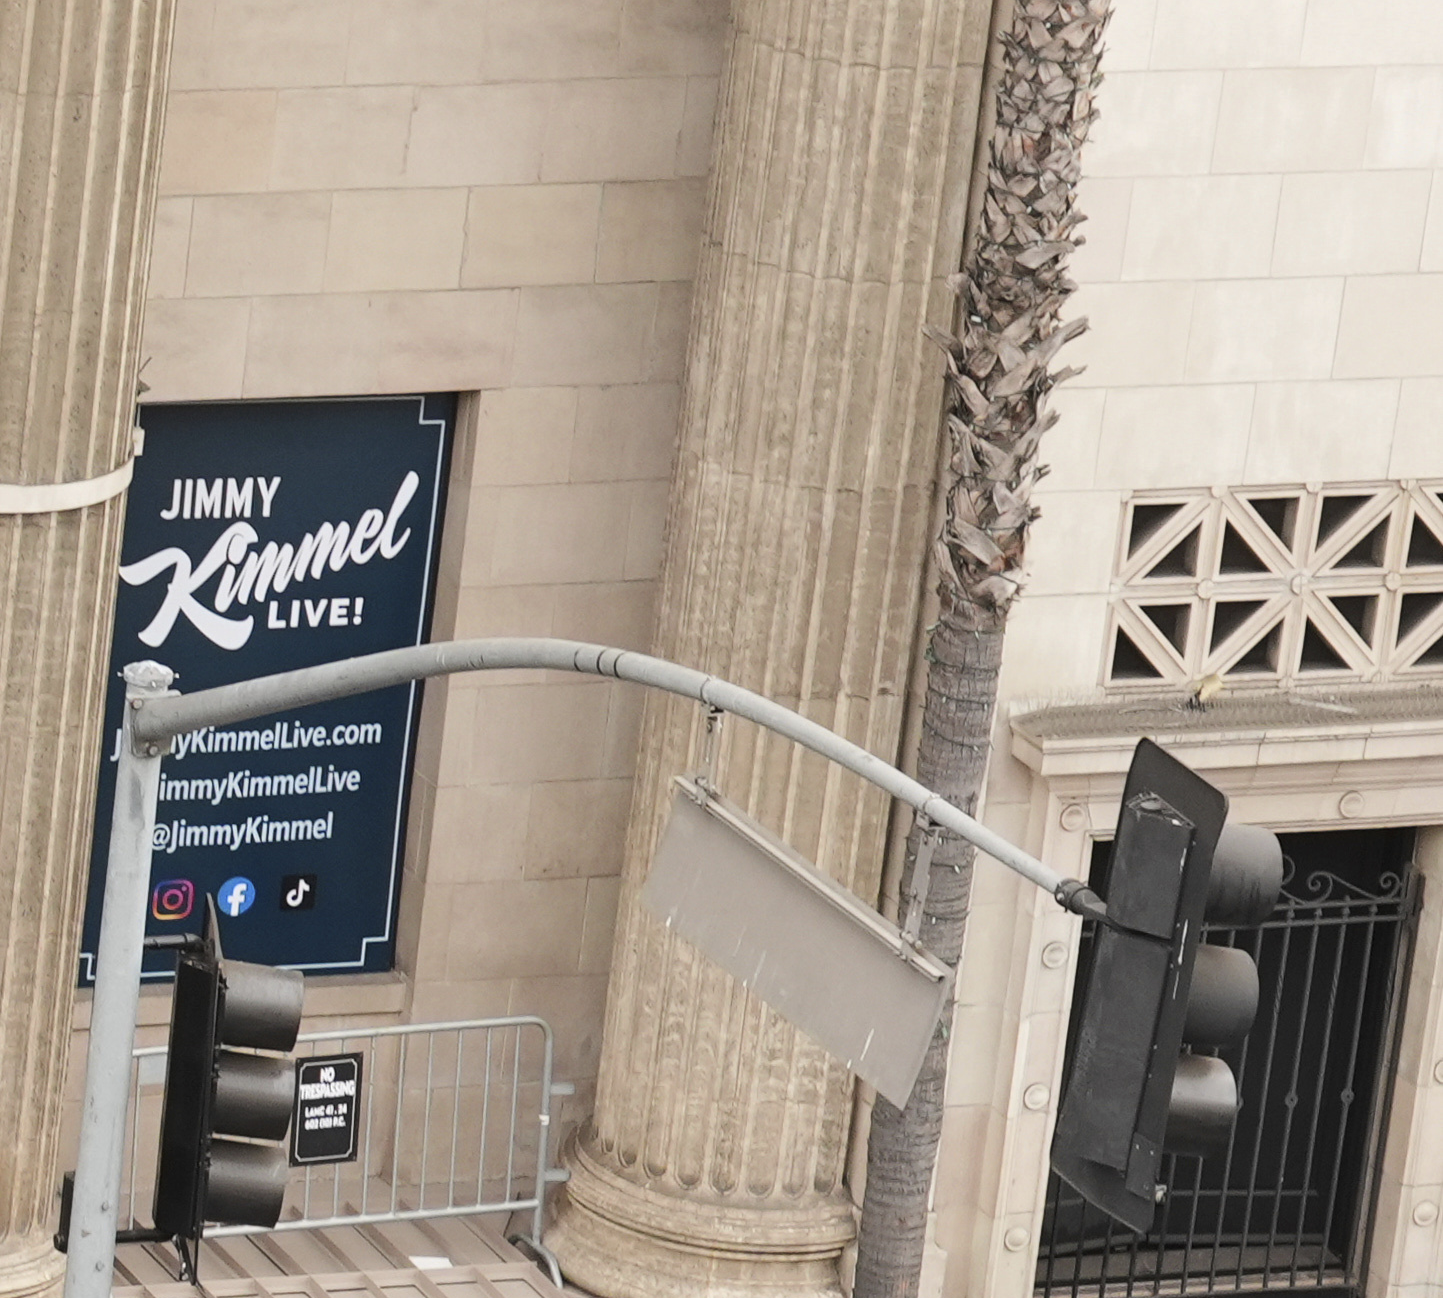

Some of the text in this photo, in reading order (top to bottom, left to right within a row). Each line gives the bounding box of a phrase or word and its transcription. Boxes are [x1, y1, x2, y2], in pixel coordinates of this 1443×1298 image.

[160, 475, 282, 521] JIMMY
[119, 470, 420, 651] Kimmel
[267, 597, 364, 630] LIVE!
[109, 720, 382, 762] JyKimmelLive.com
[159, 764, 361, 806] immyKimmelLive
[152, 810, 334, 854] @JimmyKimmel
[300, 1080, 356, 1100] TRESPASSING
[319, 1066, 336, 1083] NO
